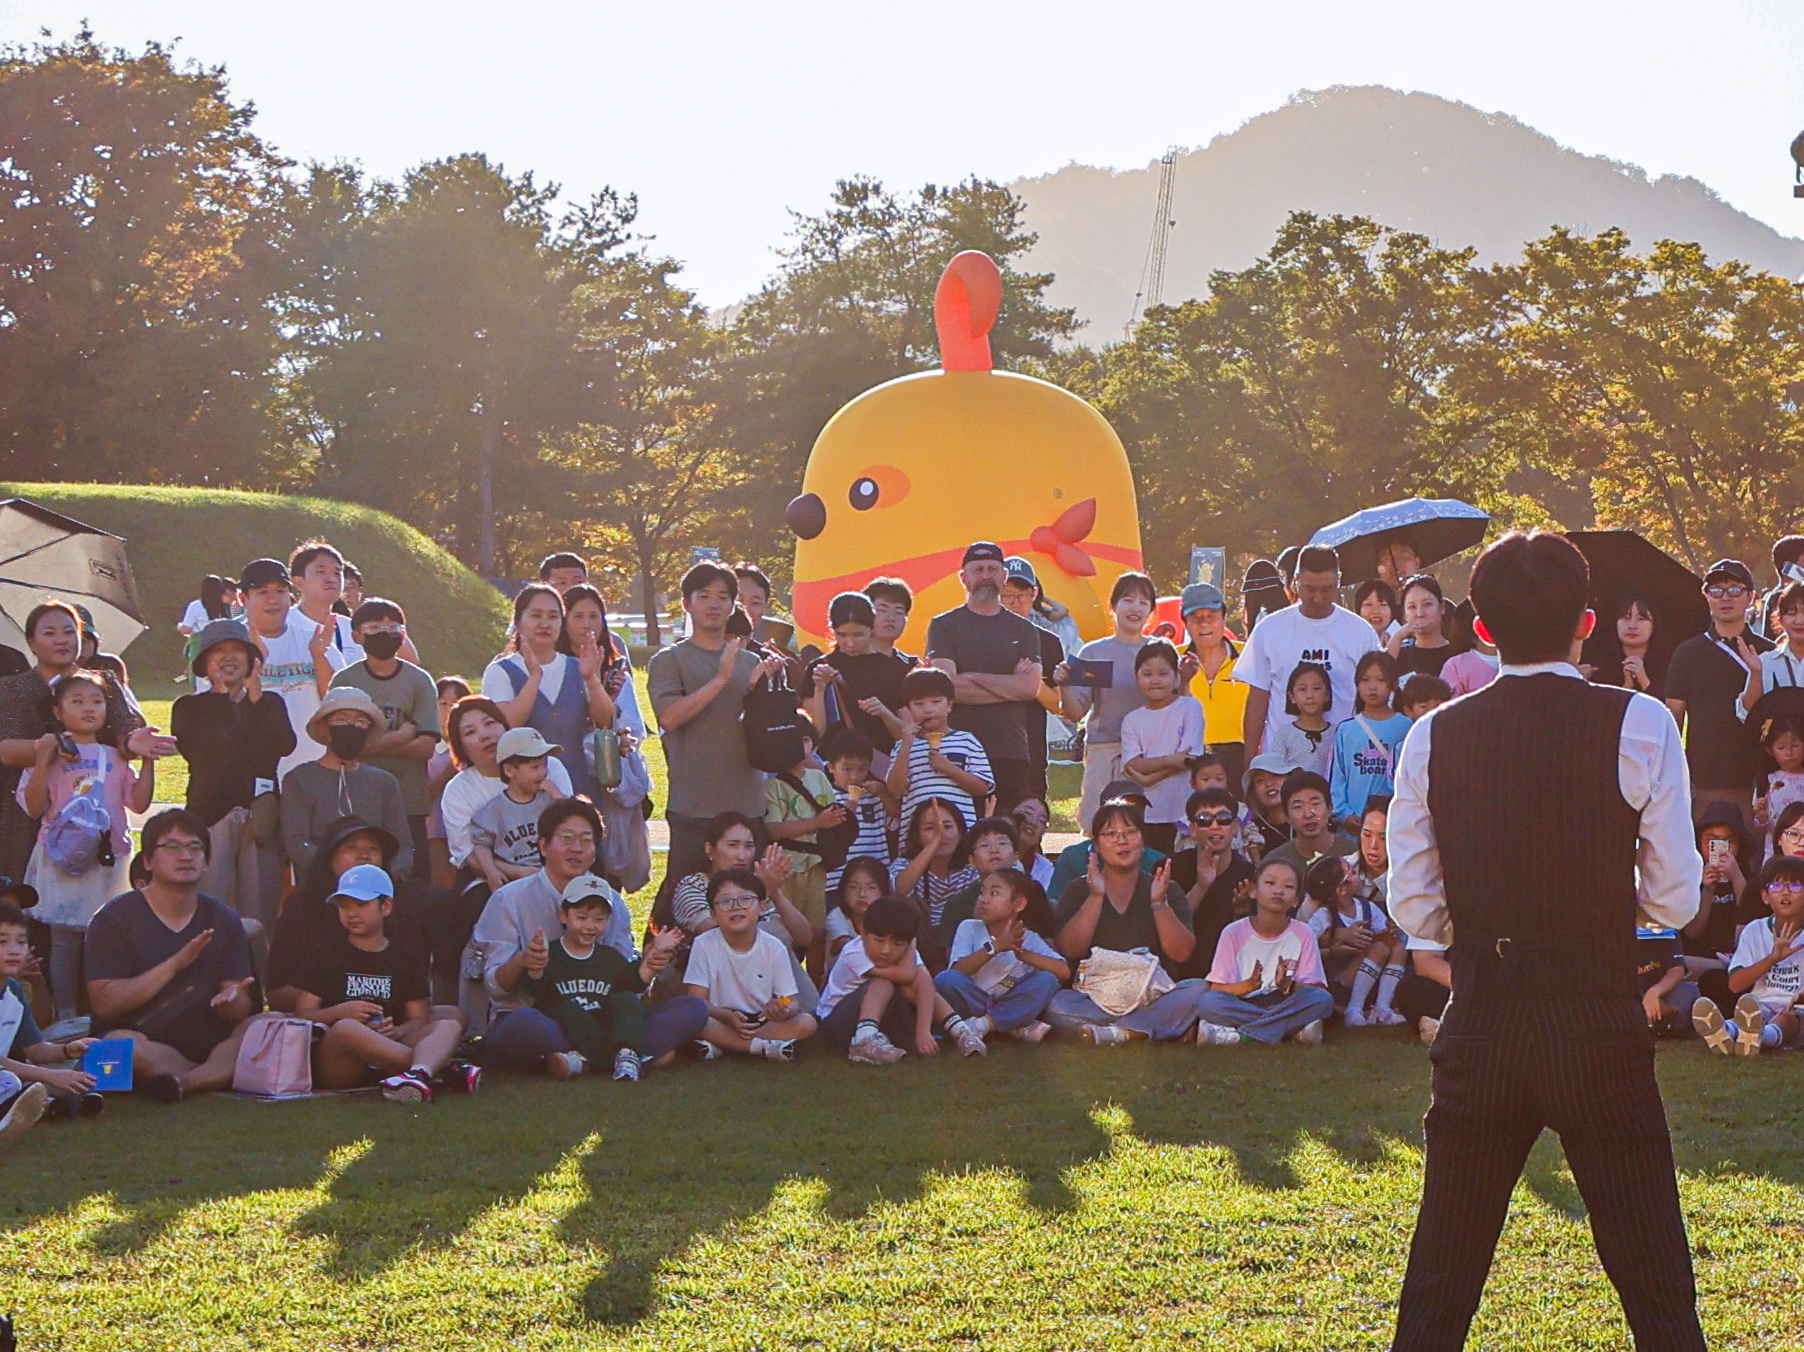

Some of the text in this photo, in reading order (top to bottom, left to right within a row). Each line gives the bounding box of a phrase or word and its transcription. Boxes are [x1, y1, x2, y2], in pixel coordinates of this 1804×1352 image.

[1009, 560, 1022, 571] NY
[1301, 649, 1329, 661] AMI
[1353, 752, 1388, 767] Skate
[1360, 765, 1387, 775] boar
